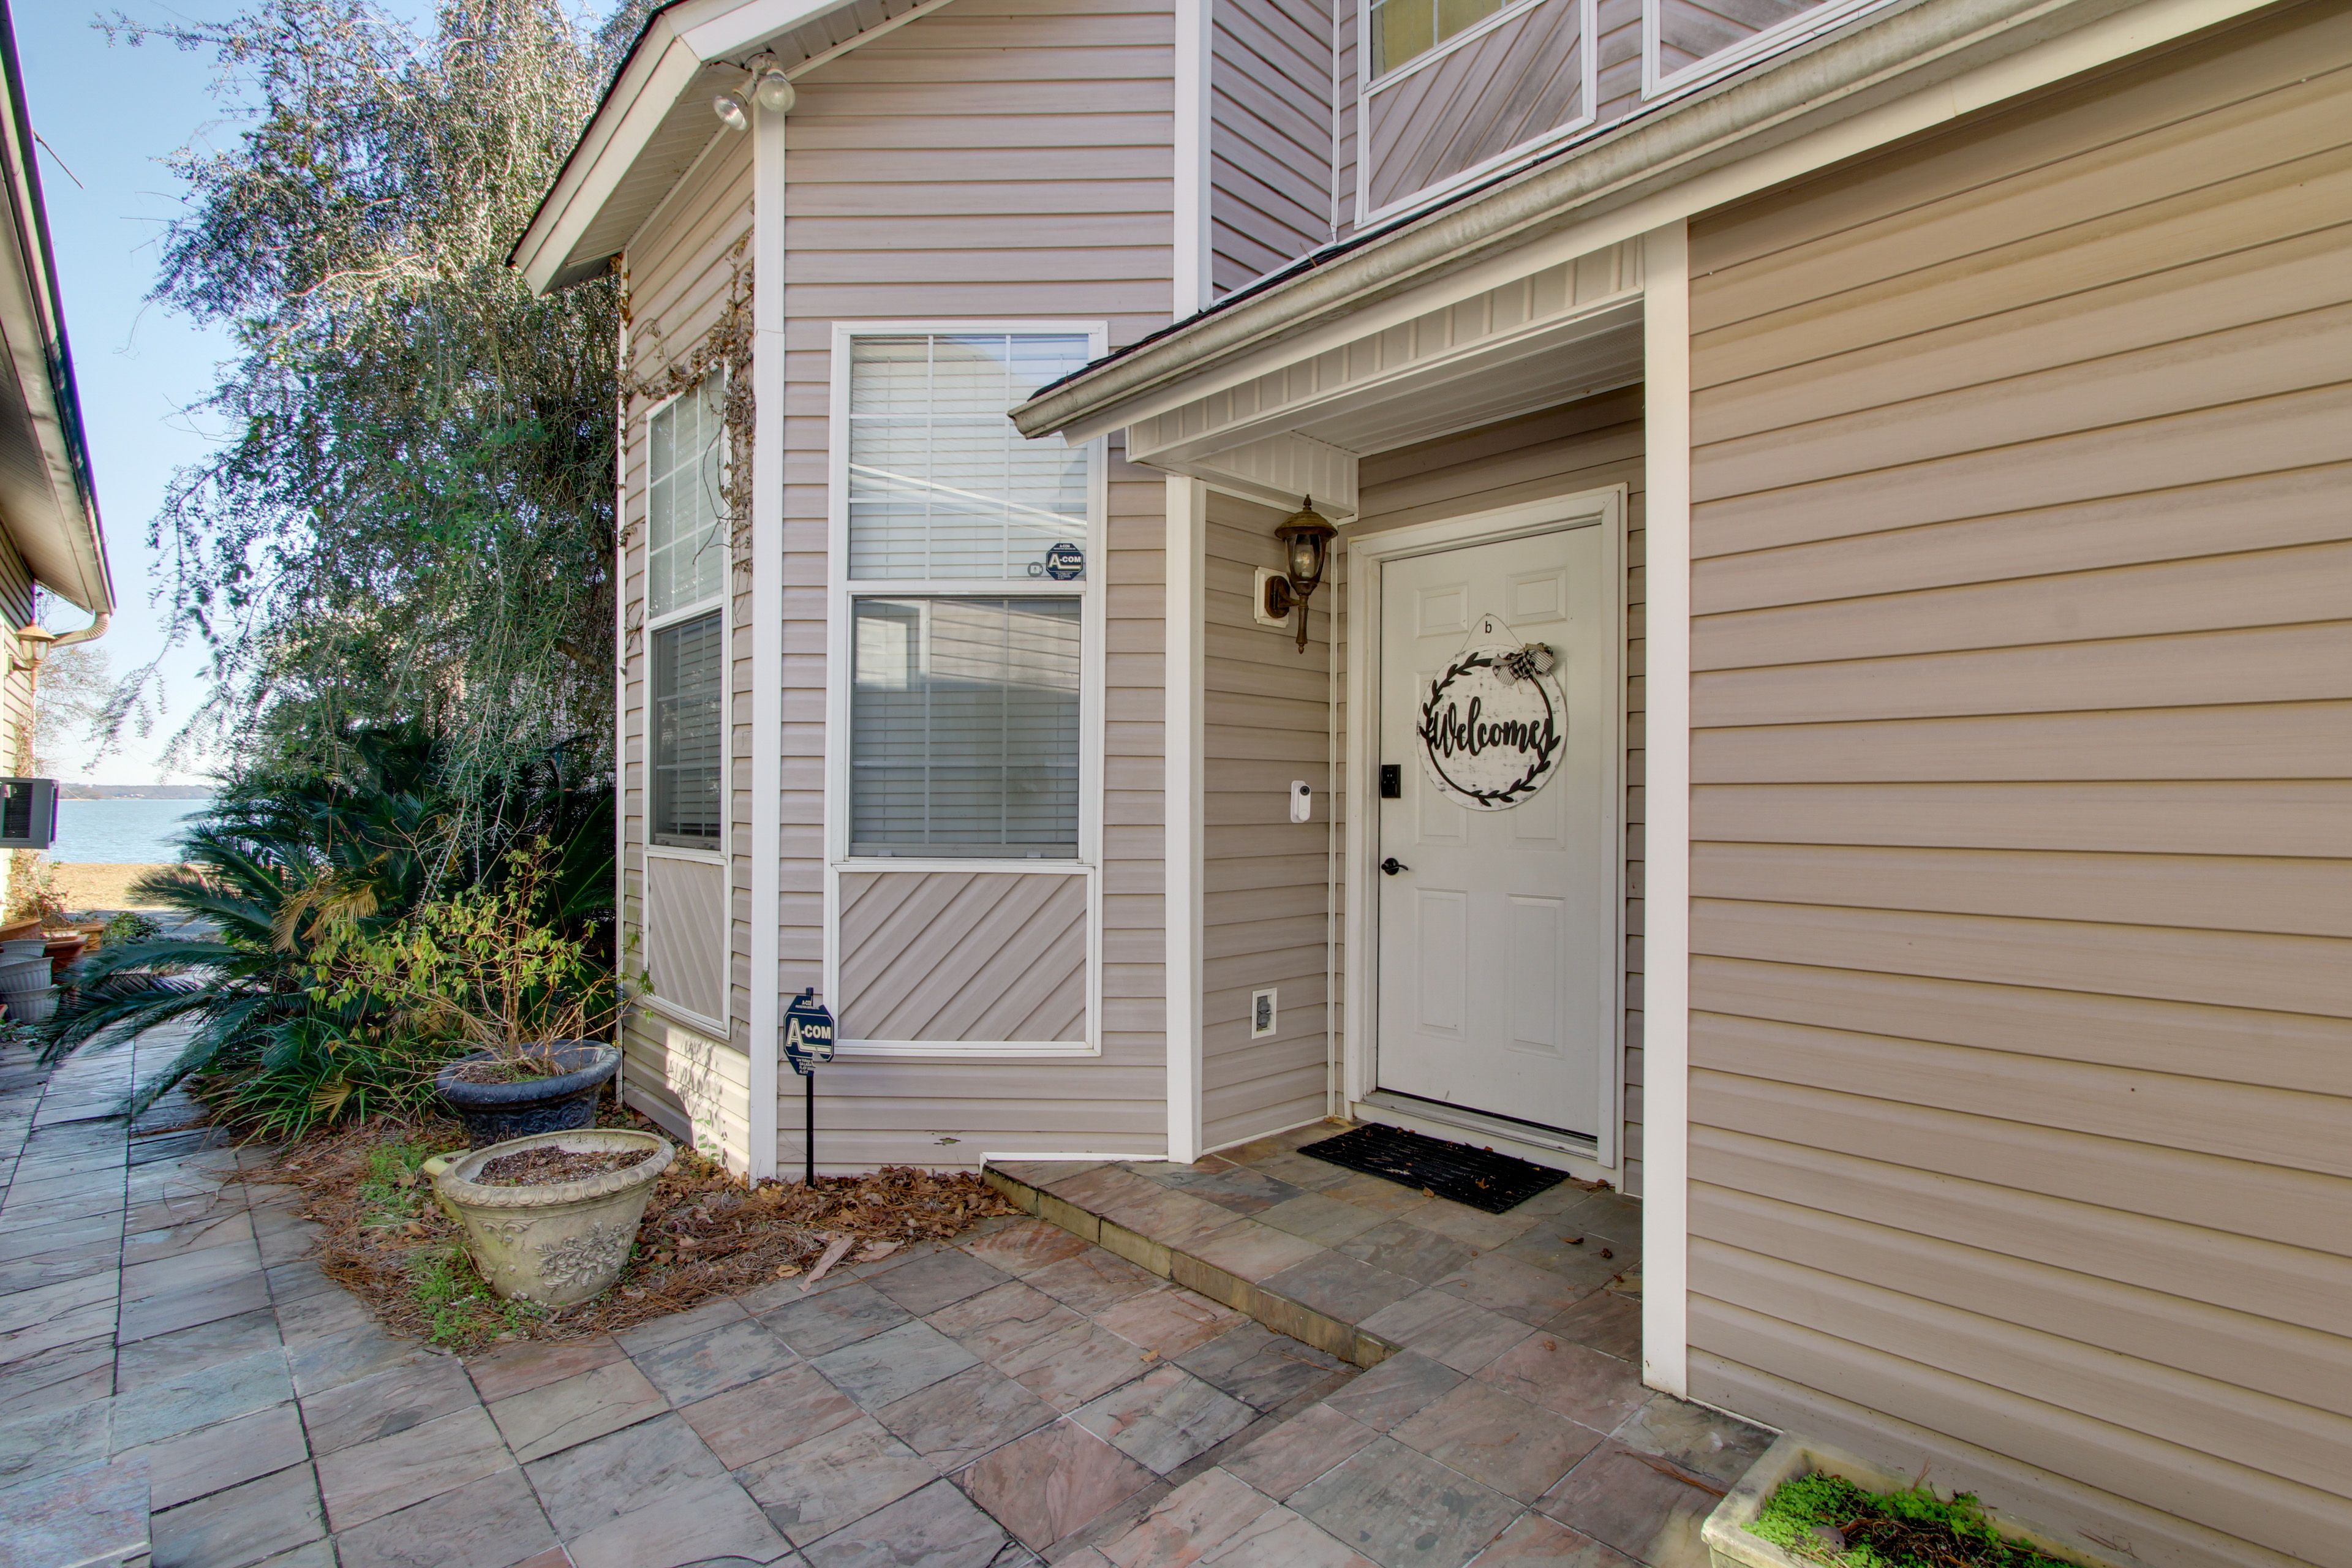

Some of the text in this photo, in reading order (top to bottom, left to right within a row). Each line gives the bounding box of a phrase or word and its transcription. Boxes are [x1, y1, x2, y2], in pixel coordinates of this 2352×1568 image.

[1048, 553, 1081, 570] A-COM
[1485, 620, 1492, 634] b
[1428, 696, 1542, 758] Welcome
[786, 1018, 831, 1054] A-COM
